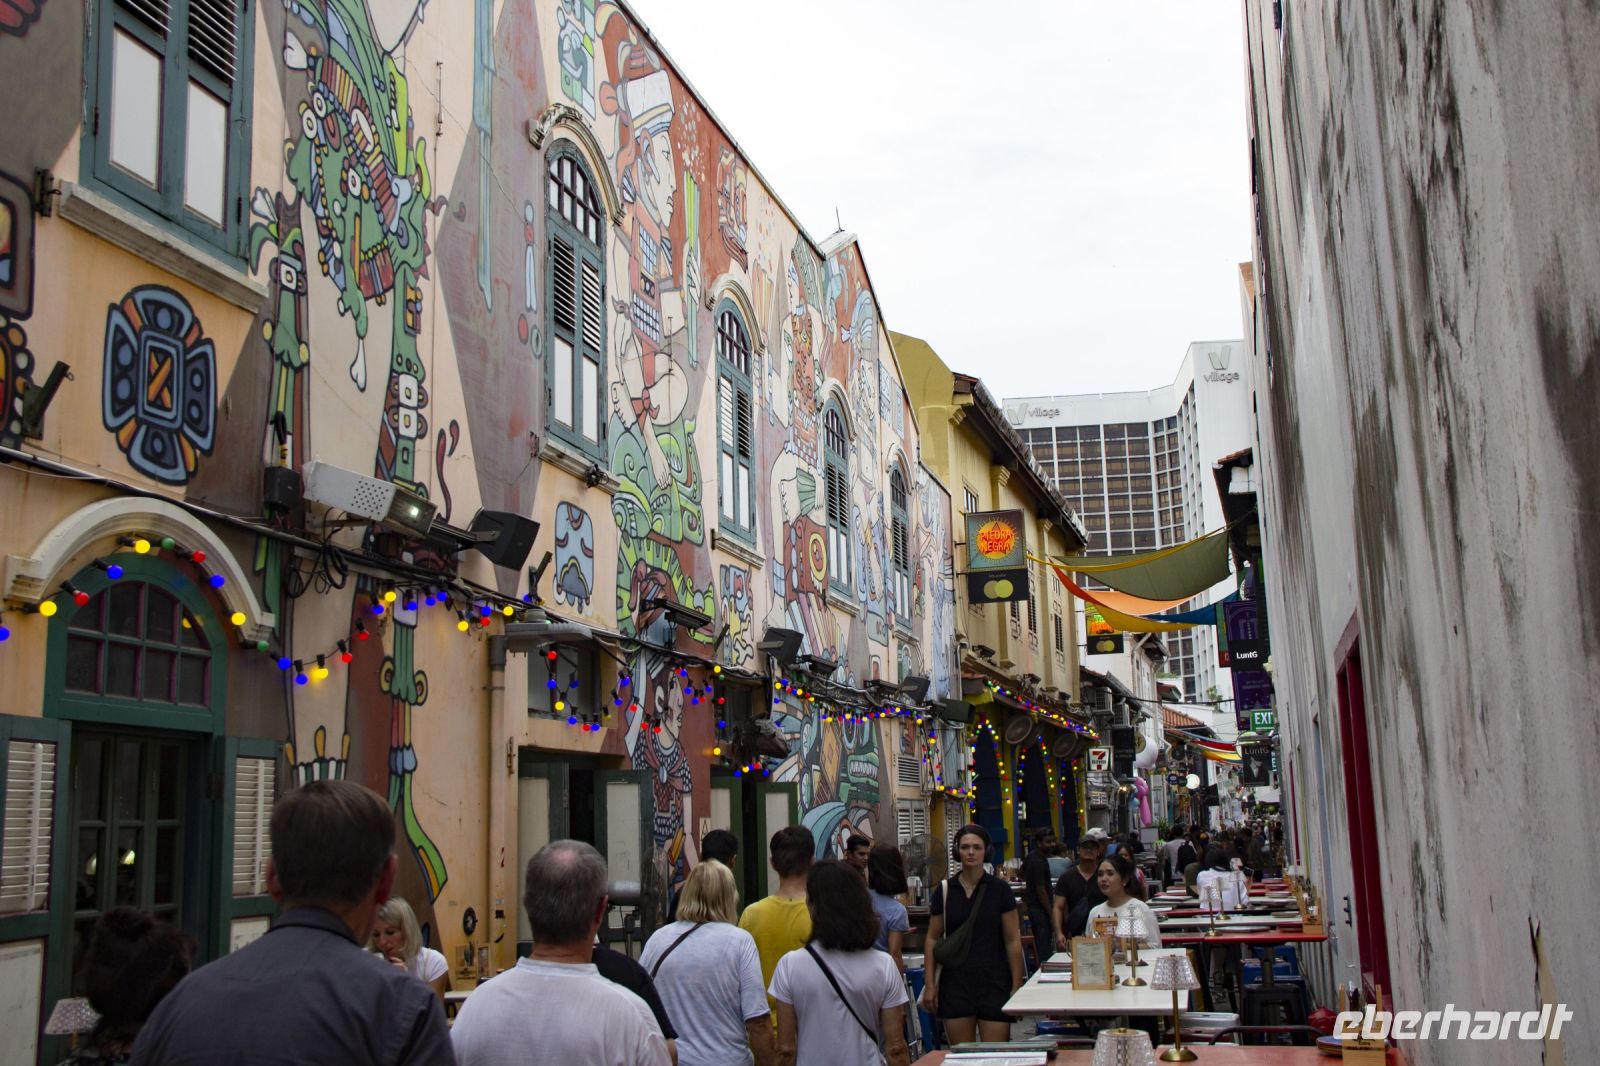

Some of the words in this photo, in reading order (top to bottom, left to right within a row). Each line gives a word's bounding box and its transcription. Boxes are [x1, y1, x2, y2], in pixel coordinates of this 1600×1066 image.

[980, 529, 1012, 540] PIEDRA
[982, 541, 1010, 553] NEGRA
[1236, 651, 1258, 659] LuntG
[1254, 712, 1273, 724] EXI
